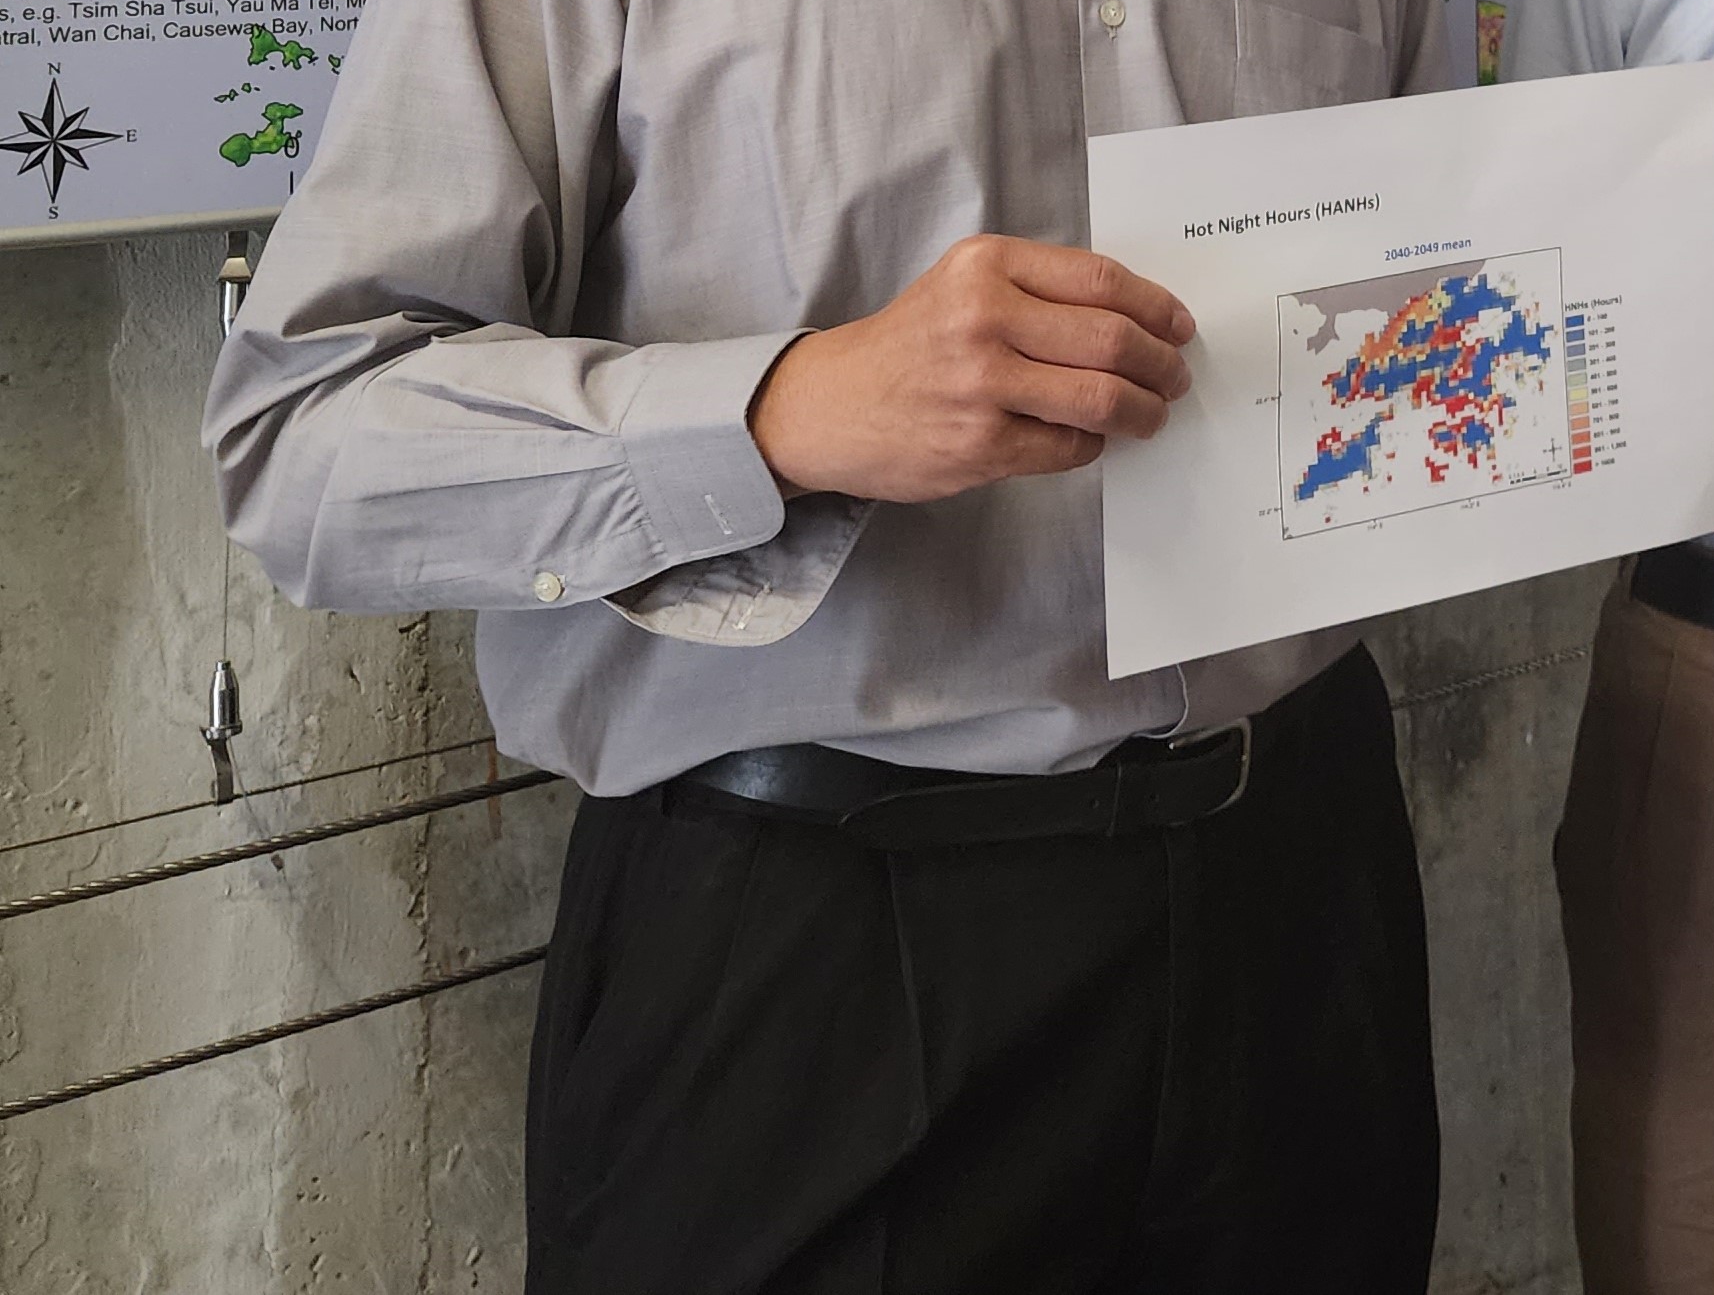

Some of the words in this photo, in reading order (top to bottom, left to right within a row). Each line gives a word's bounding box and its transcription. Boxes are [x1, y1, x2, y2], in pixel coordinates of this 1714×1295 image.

[22, 8, 60, 24] e.g.
[69, 2, 119, 19] Tsim
[125, 0, 164, 17] Sha
[50, 26, 97, 44] Wan
[103, 23, 156, 43] Chai,
[163, 20, 266, 40] Causeway
[273, 16, 314, 37] Bay,
[48, 62, 61, 75] N
[125, 129, 137, 143] E
[48, 207, 59, 220] S
[1184, 221, 1213, 239] Hot
[1219, 214, 1260, 234] Night
[1266, 207, 1311, 225] Hours
[1315, 193, 1380, 221] (HANHs)
[1385, 242, 1439, 261] 2040-2049
[1442, 239, 1472, 251] mean
[1591, 295, 1623, 310] (Hours)
